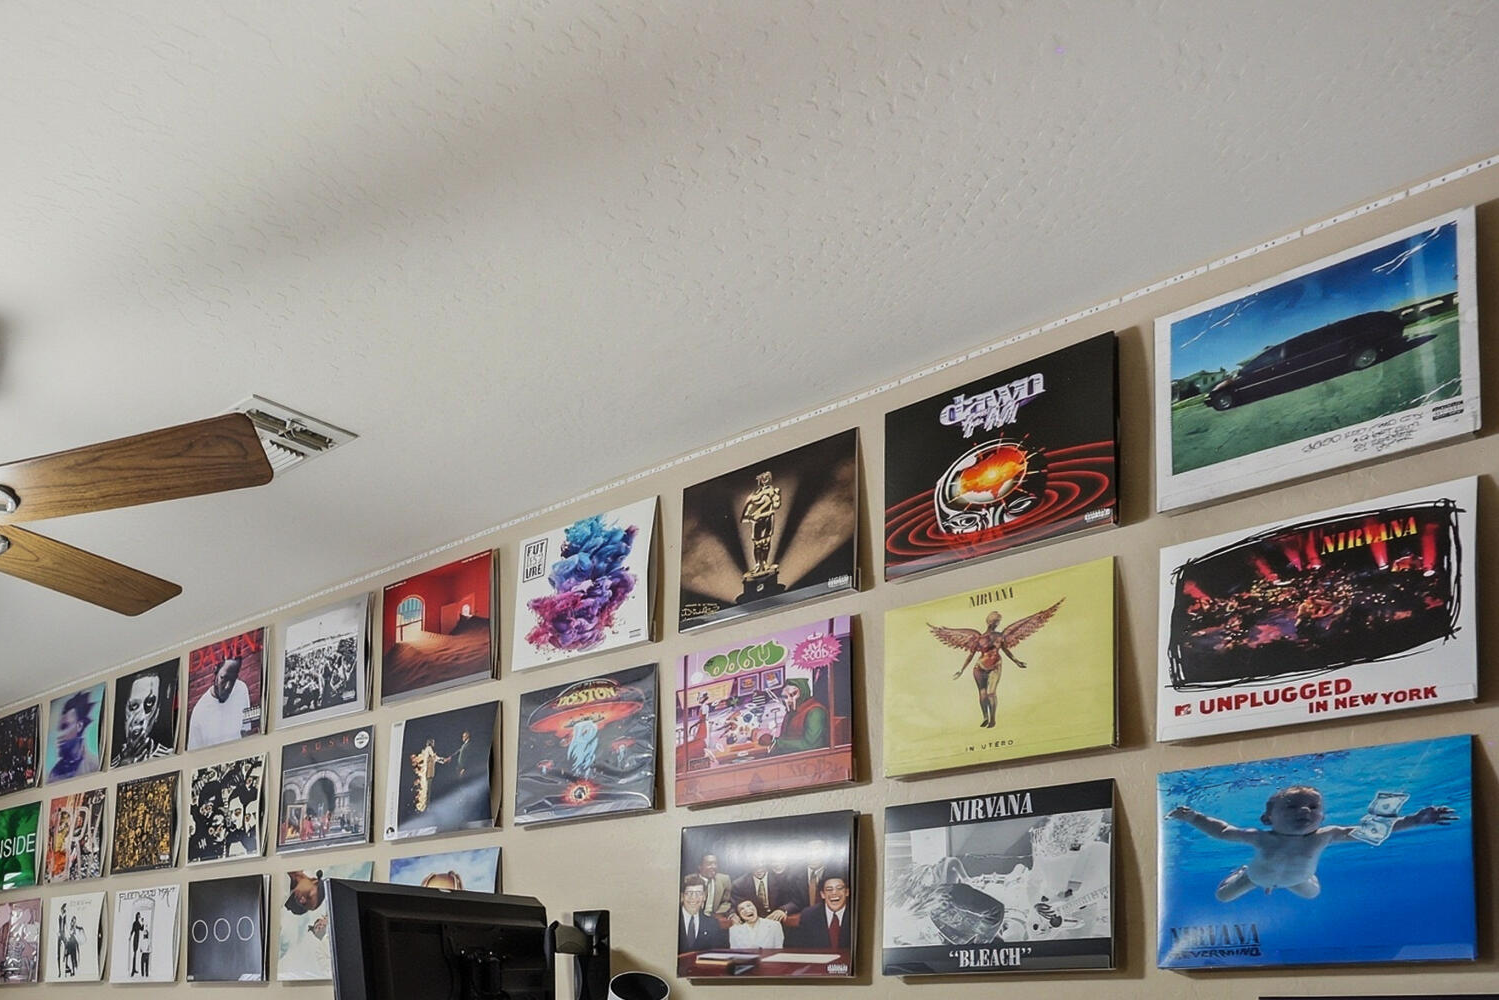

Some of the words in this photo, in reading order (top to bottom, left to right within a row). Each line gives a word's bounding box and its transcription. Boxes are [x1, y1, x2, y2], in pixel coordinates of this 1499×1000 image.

[1321, 516, 1418, 556] NIRVANA
[969, 587, 1014, 608] NIRVANA
[557, 686, 618, 708] BOSTON
[1199, 677, 1352, 715] UNPLUGGED
[1308, 700, 1329, 714] IN
[1333, 690, 1378, 711] NEW
[1381, 685, 1438, 705] YORK
[980, 739, 1015, 750] UTERO
[949, 792, 1033, 823] NIRVANA
